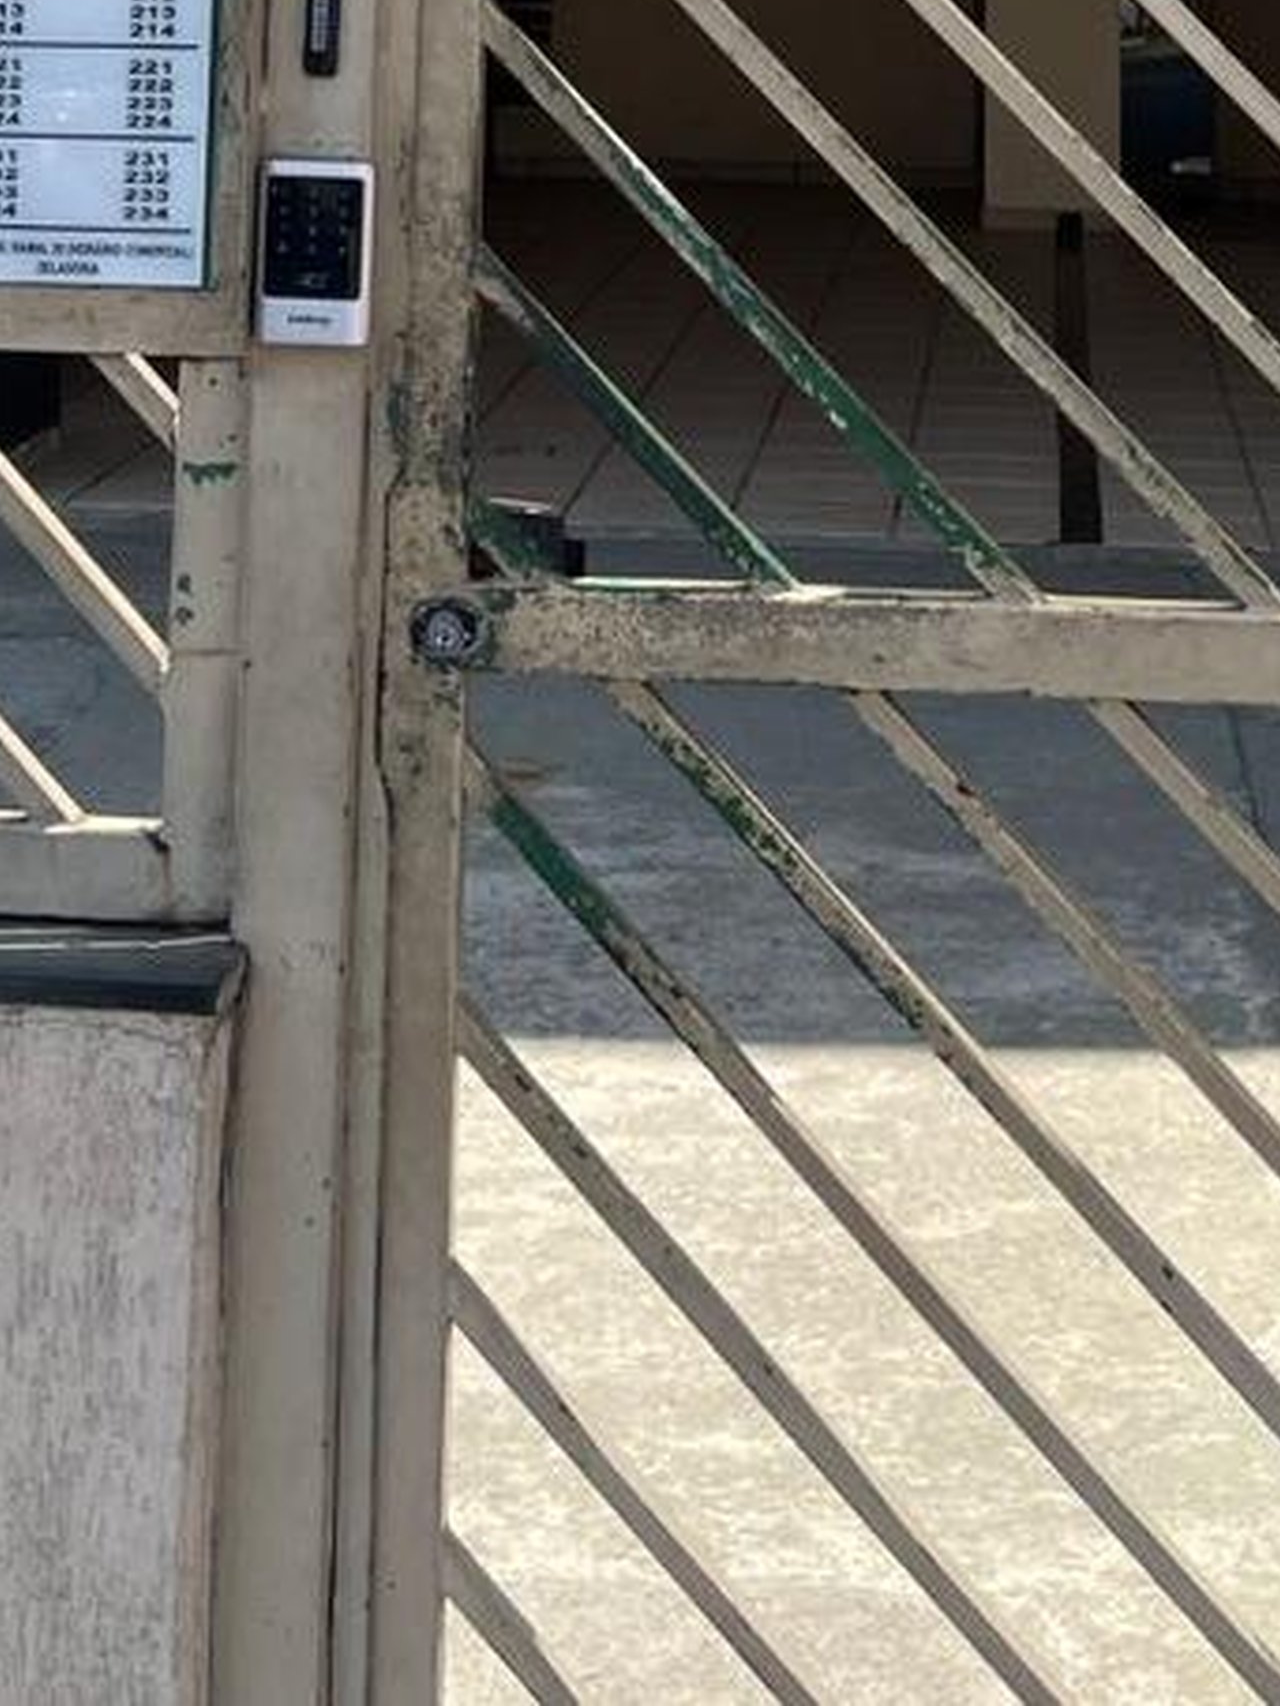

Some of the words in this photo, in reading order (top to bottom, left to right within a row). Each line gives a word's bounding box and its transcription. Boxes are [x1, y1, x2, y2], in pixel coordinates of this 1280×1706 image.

[130, 22, 176, 38] 214
[128, 59, 172, 75] 221
[126, 113, 172, 129] 224
[124, 150, 169, 167] 231
[124, 169, 170, 185] 232
[124, 206, 169, 222] 234
